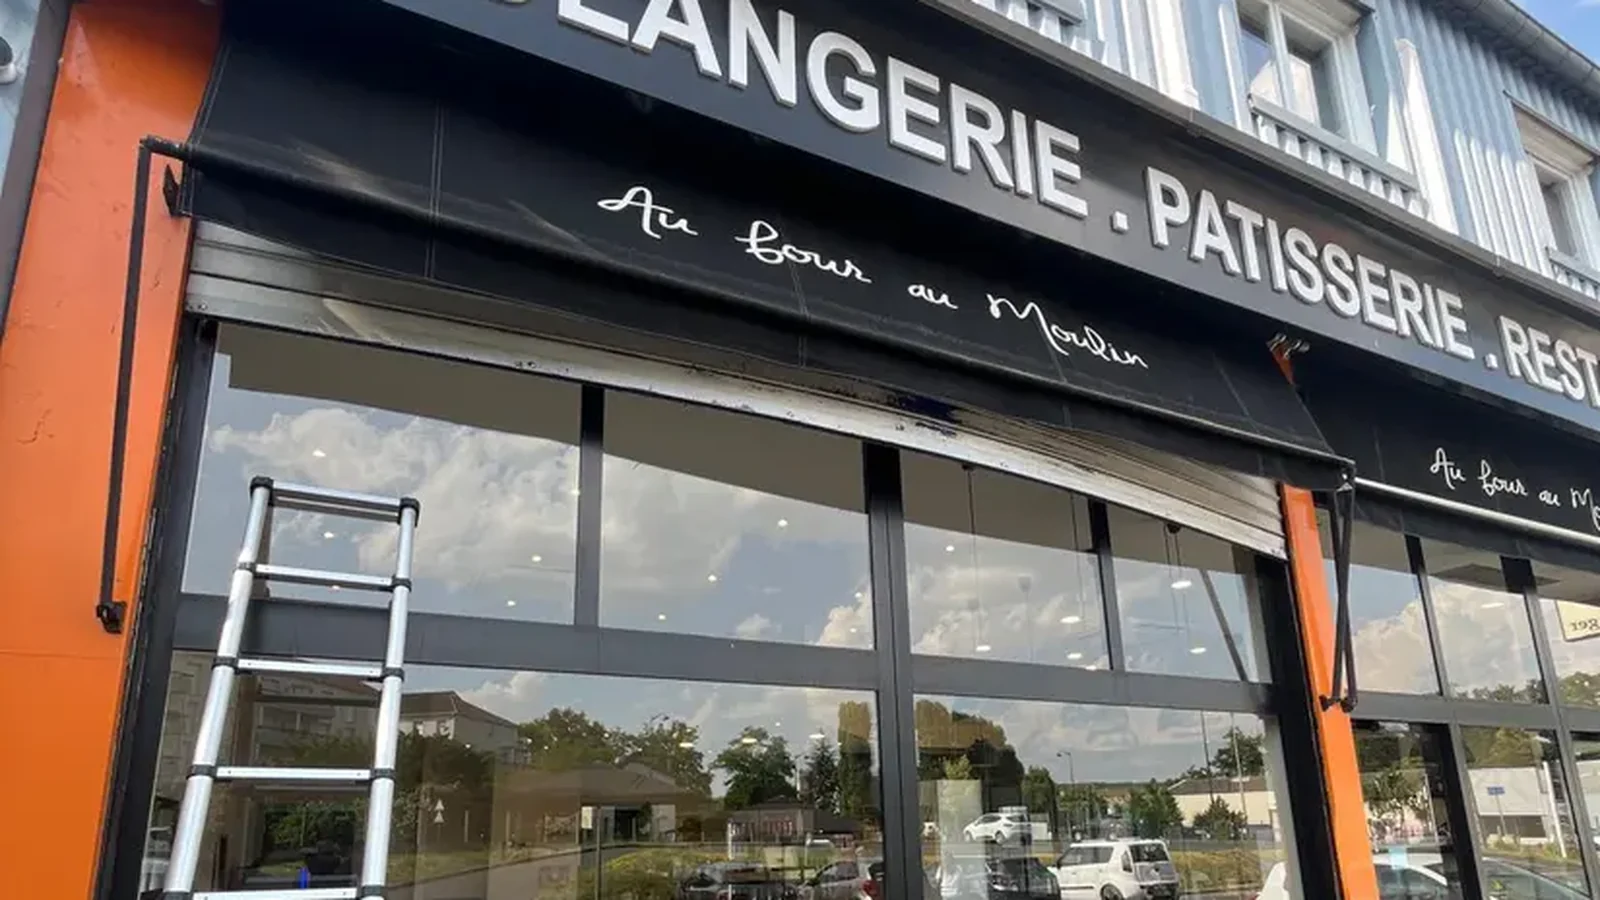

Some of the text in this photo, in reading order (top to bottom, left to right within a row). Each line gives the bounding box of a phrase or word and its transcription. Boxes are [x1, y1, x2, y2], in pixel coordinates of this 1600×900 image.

[597, 186, 1148, 369] Au four au Moulin
[1144, 166, 1474, 361] PATISSERIE
[1430, 447, 1466, 490] Au
[1477, 459, 1528, 496] four
[1538, 490, 1560, 507] au
